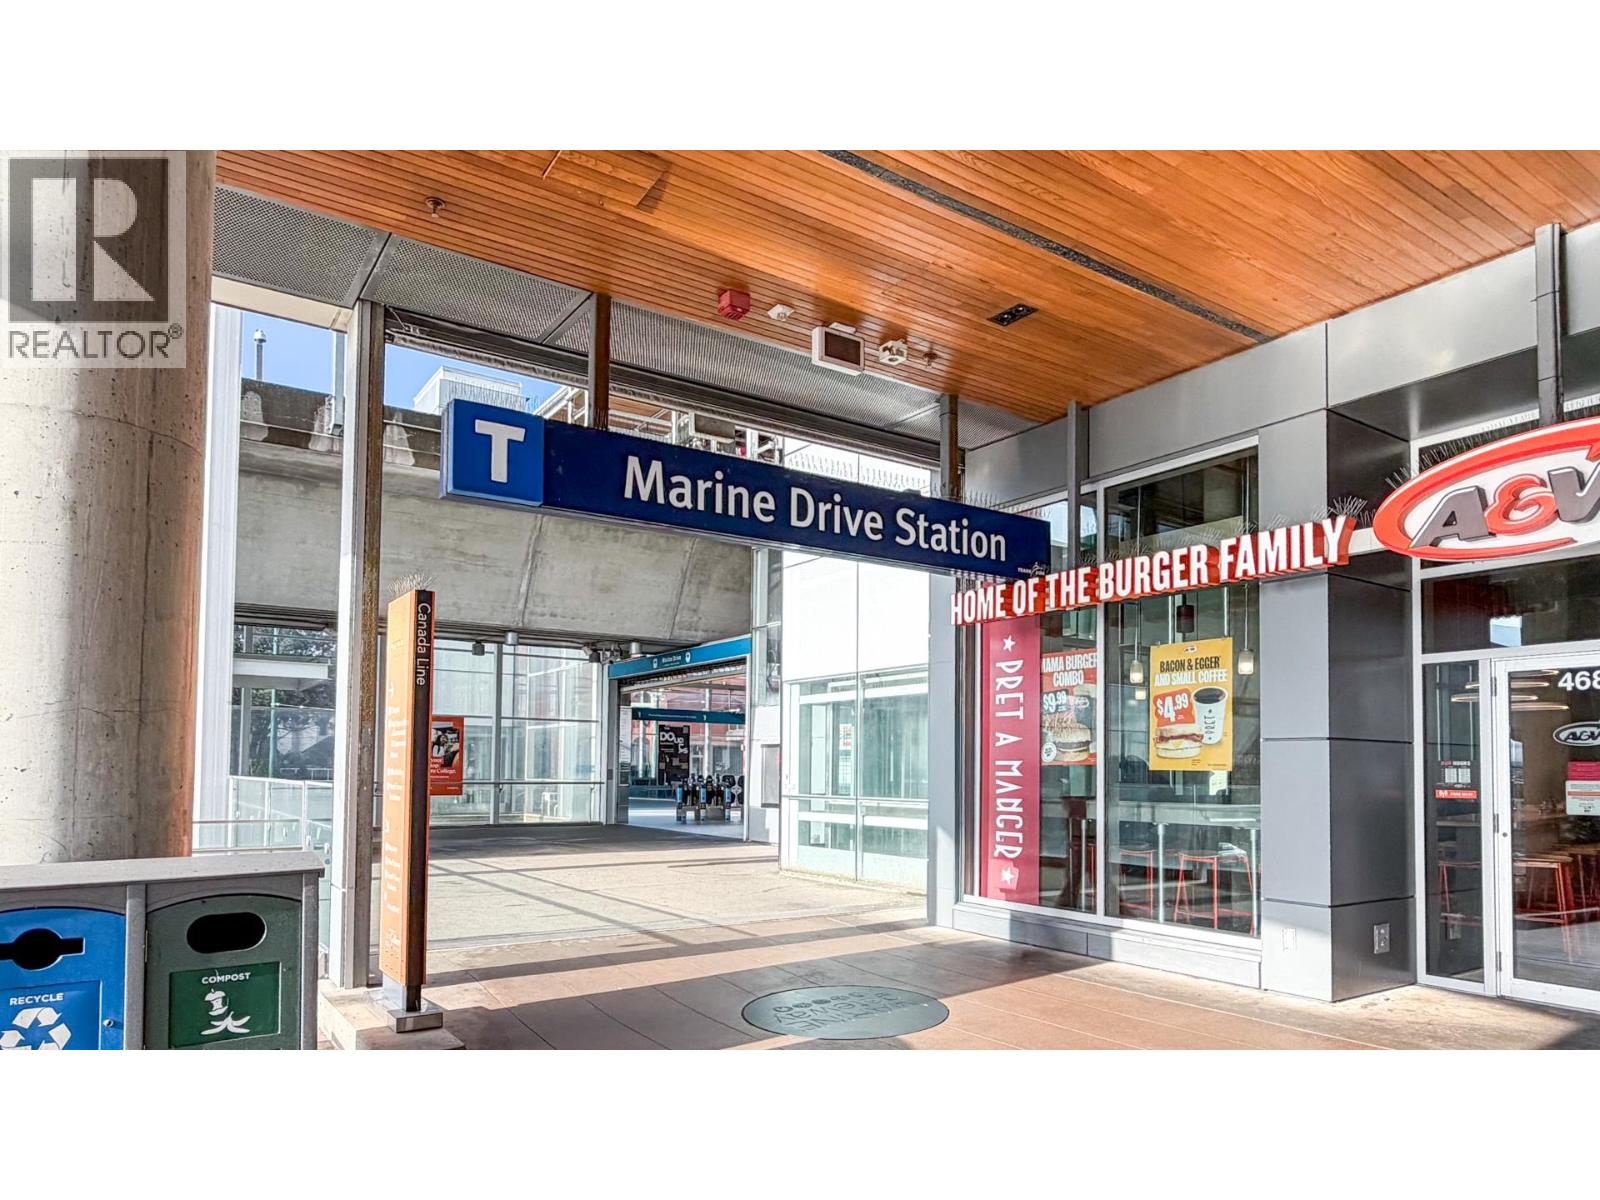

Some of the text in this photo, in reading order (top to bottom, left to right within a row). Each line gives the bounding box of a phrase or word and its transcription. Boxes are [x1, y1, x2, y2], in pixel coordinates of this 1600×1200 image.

[475, 419, 526, 484] T
[623, 454, 1007, 562] Marine Drive Station
[950, 515, 1347, 626] HOME OF THE BURGER FAMILY
[416, 602, 431, 686] Canada Line
[1160, 655, 1220, 673] BACON & EGGER
[994, 659, 1024, 720] PRET
[1053, 669, 1084, 688] COMBO
[1154, 668, 1228, 687] AND SMALL COFFEE
[1156, 692, 1189, 723] $4.99
[994, 732, 1023, 747] A
[201, 971, 251, 985] COMPOST
[9, 992, 65, 1006] RECYCLE
